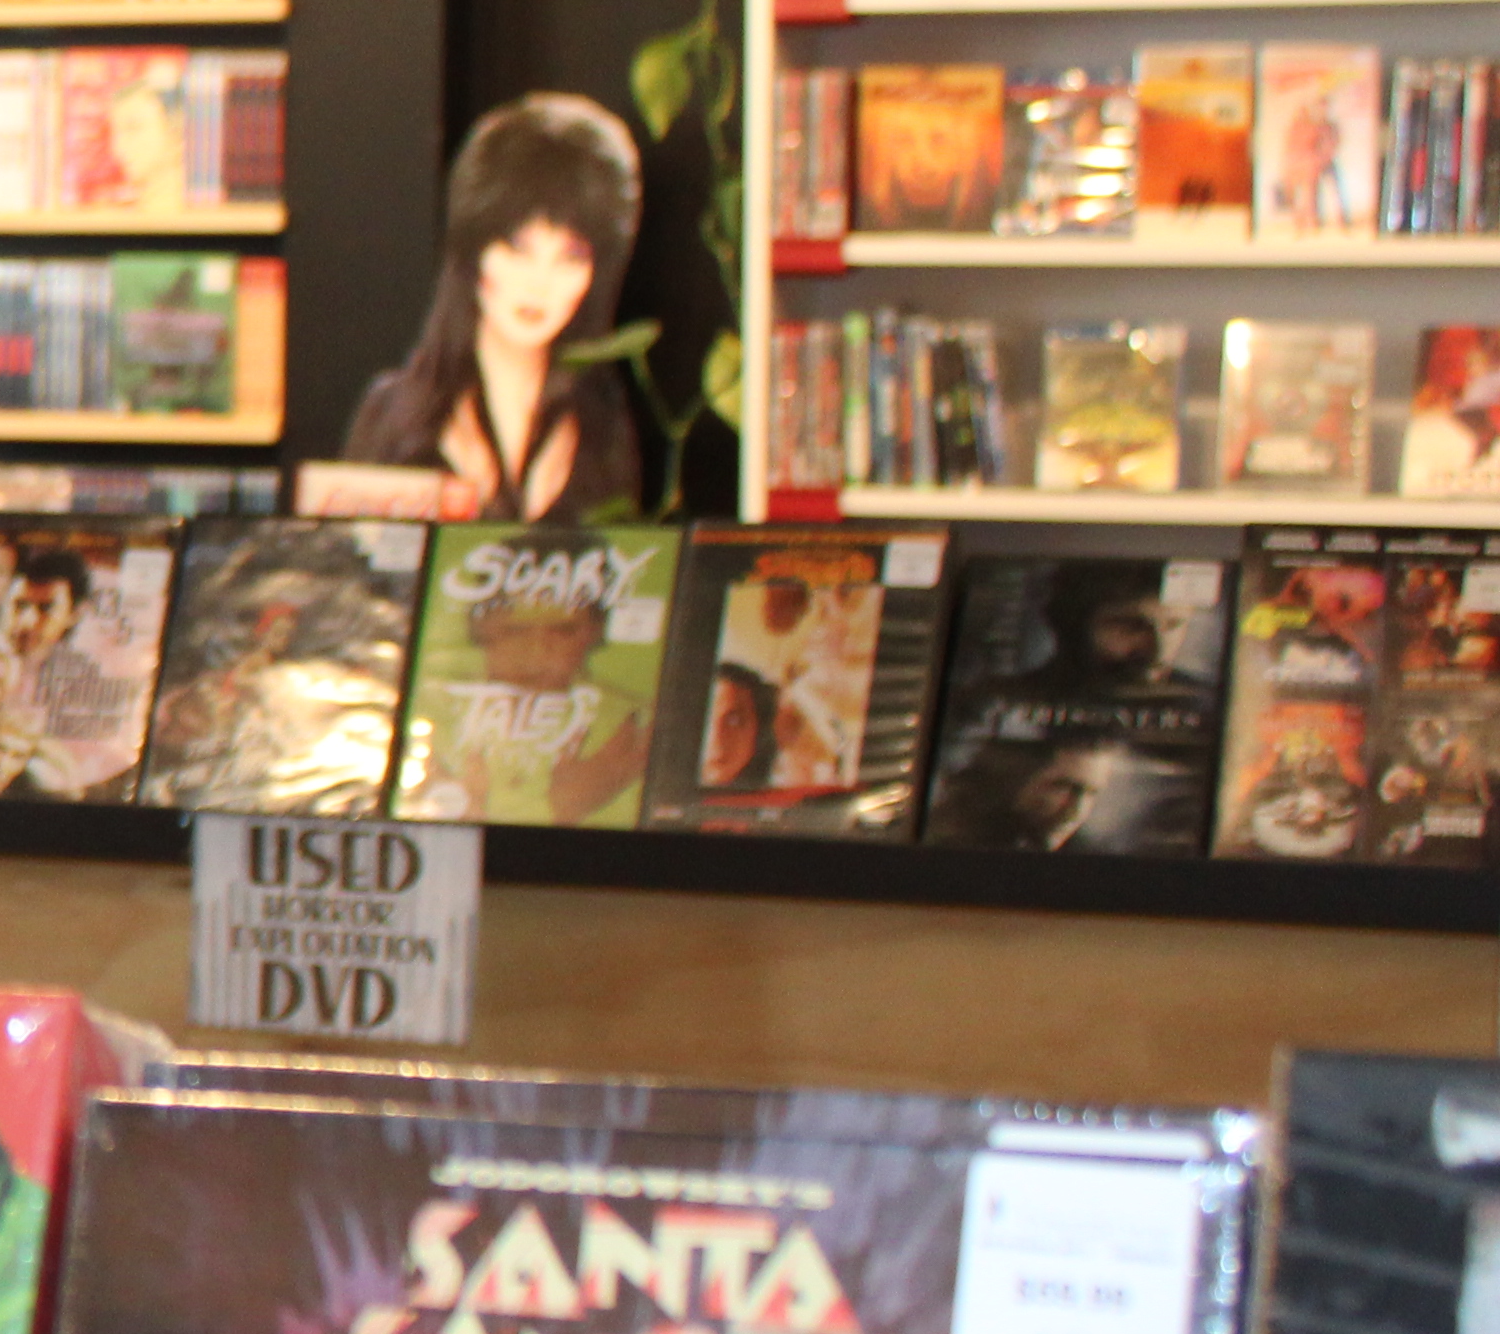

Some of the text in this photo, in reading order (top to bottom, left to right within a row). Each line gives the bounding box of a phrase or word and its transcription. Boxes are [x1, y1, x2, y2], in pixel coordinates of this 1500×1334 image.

[440, 541, 658, 617] SCARY
[447, 681, 602, 757] TALES
[250, 824, 422, 895] USED
[259, 961, 397, 1029] DVD
[430, 1154, 833, 1212] JODOROWSKY'S
